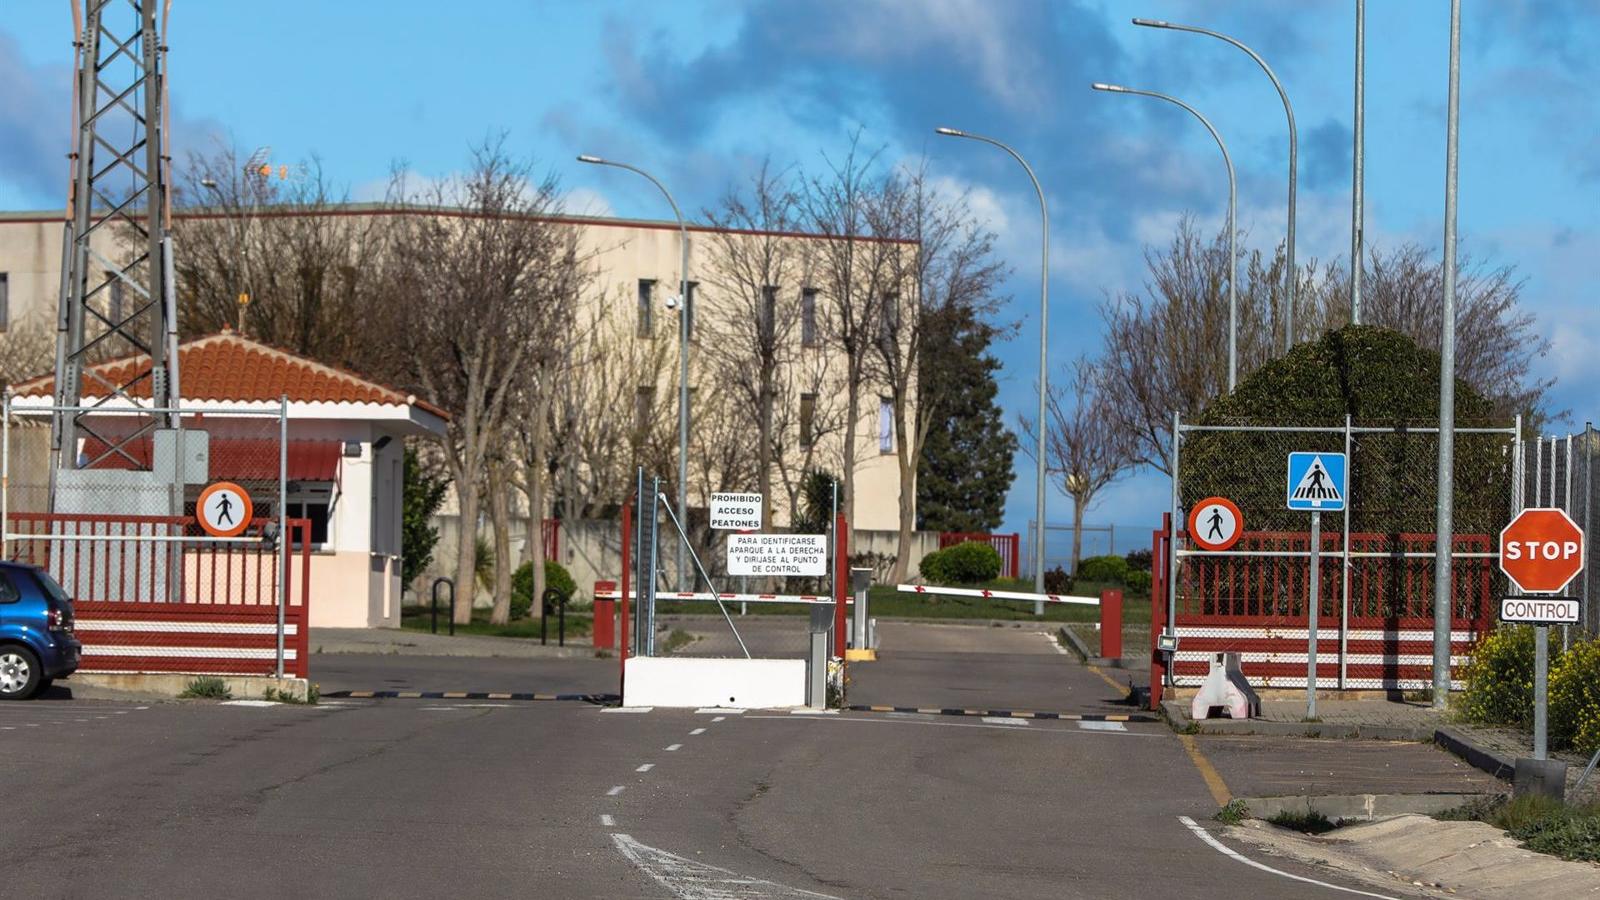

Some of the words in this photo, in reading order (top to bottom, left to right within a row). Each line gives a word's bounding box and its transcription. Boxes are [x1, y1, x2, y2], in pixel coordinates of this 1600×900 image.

[712, 495, 761, 503] PROHIBIDO
[1506, 541, 1578, 560] STOP
[765, 565, 801, 573] CONTROL
[1504, 602, 1575, 619] CONTROL
